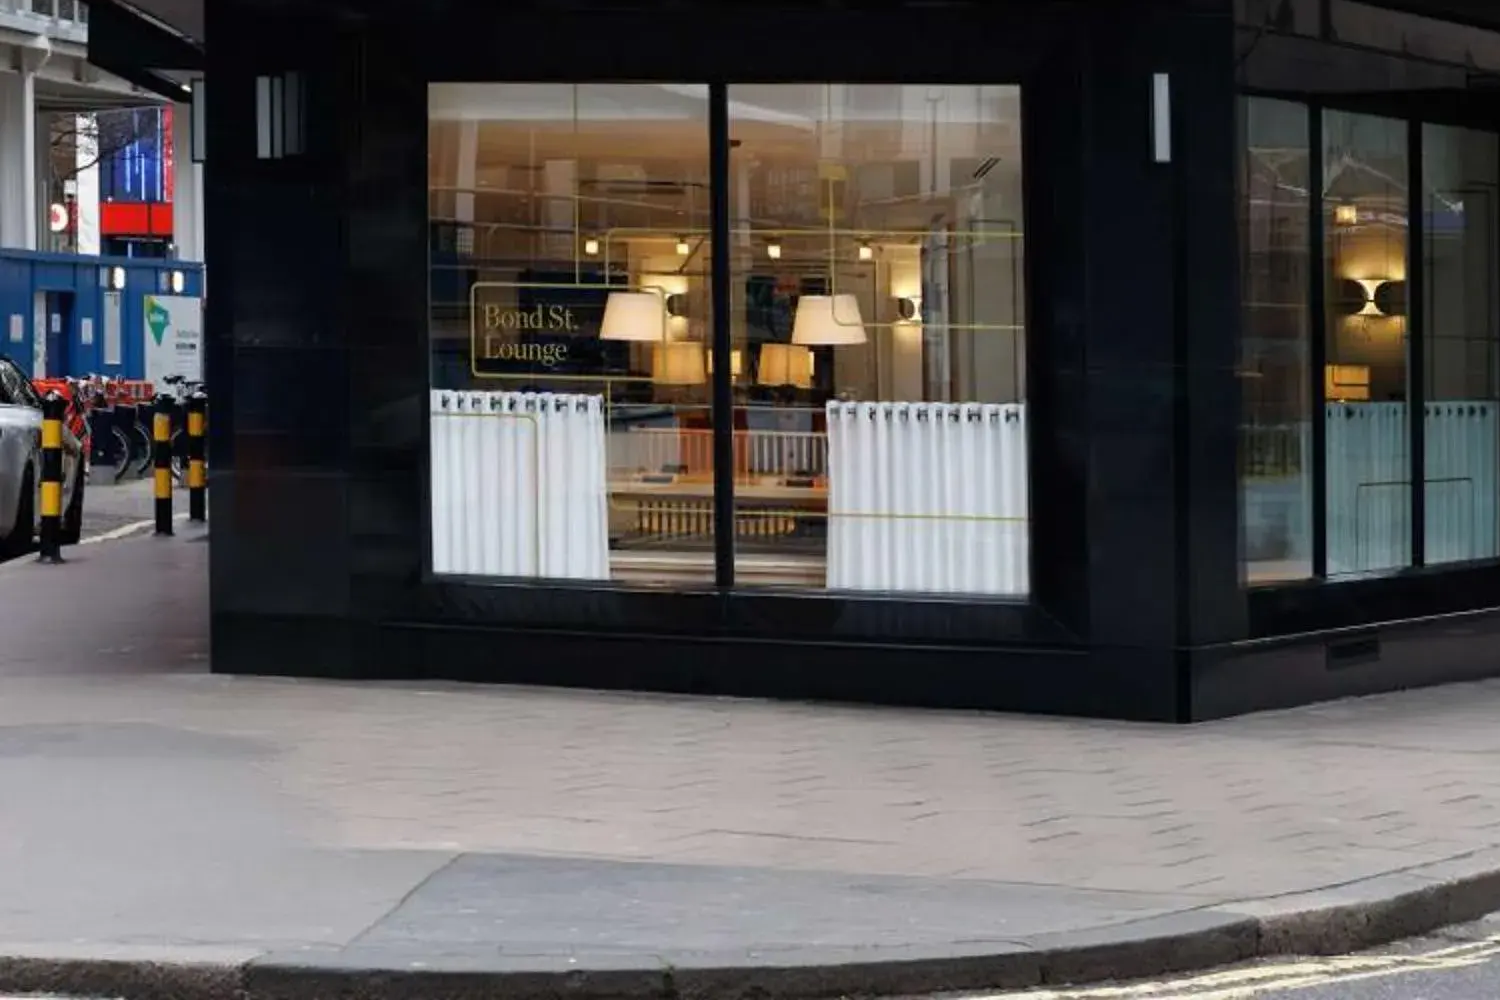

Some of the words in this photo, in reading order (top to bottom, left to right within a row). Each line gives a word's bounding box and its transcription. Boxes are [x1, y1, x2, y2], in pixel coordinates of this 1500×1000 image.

[484, 303, 543, 329] Bond
[549, 304, 580, 331] St.
[484, 334, 568, 367] Lounge
